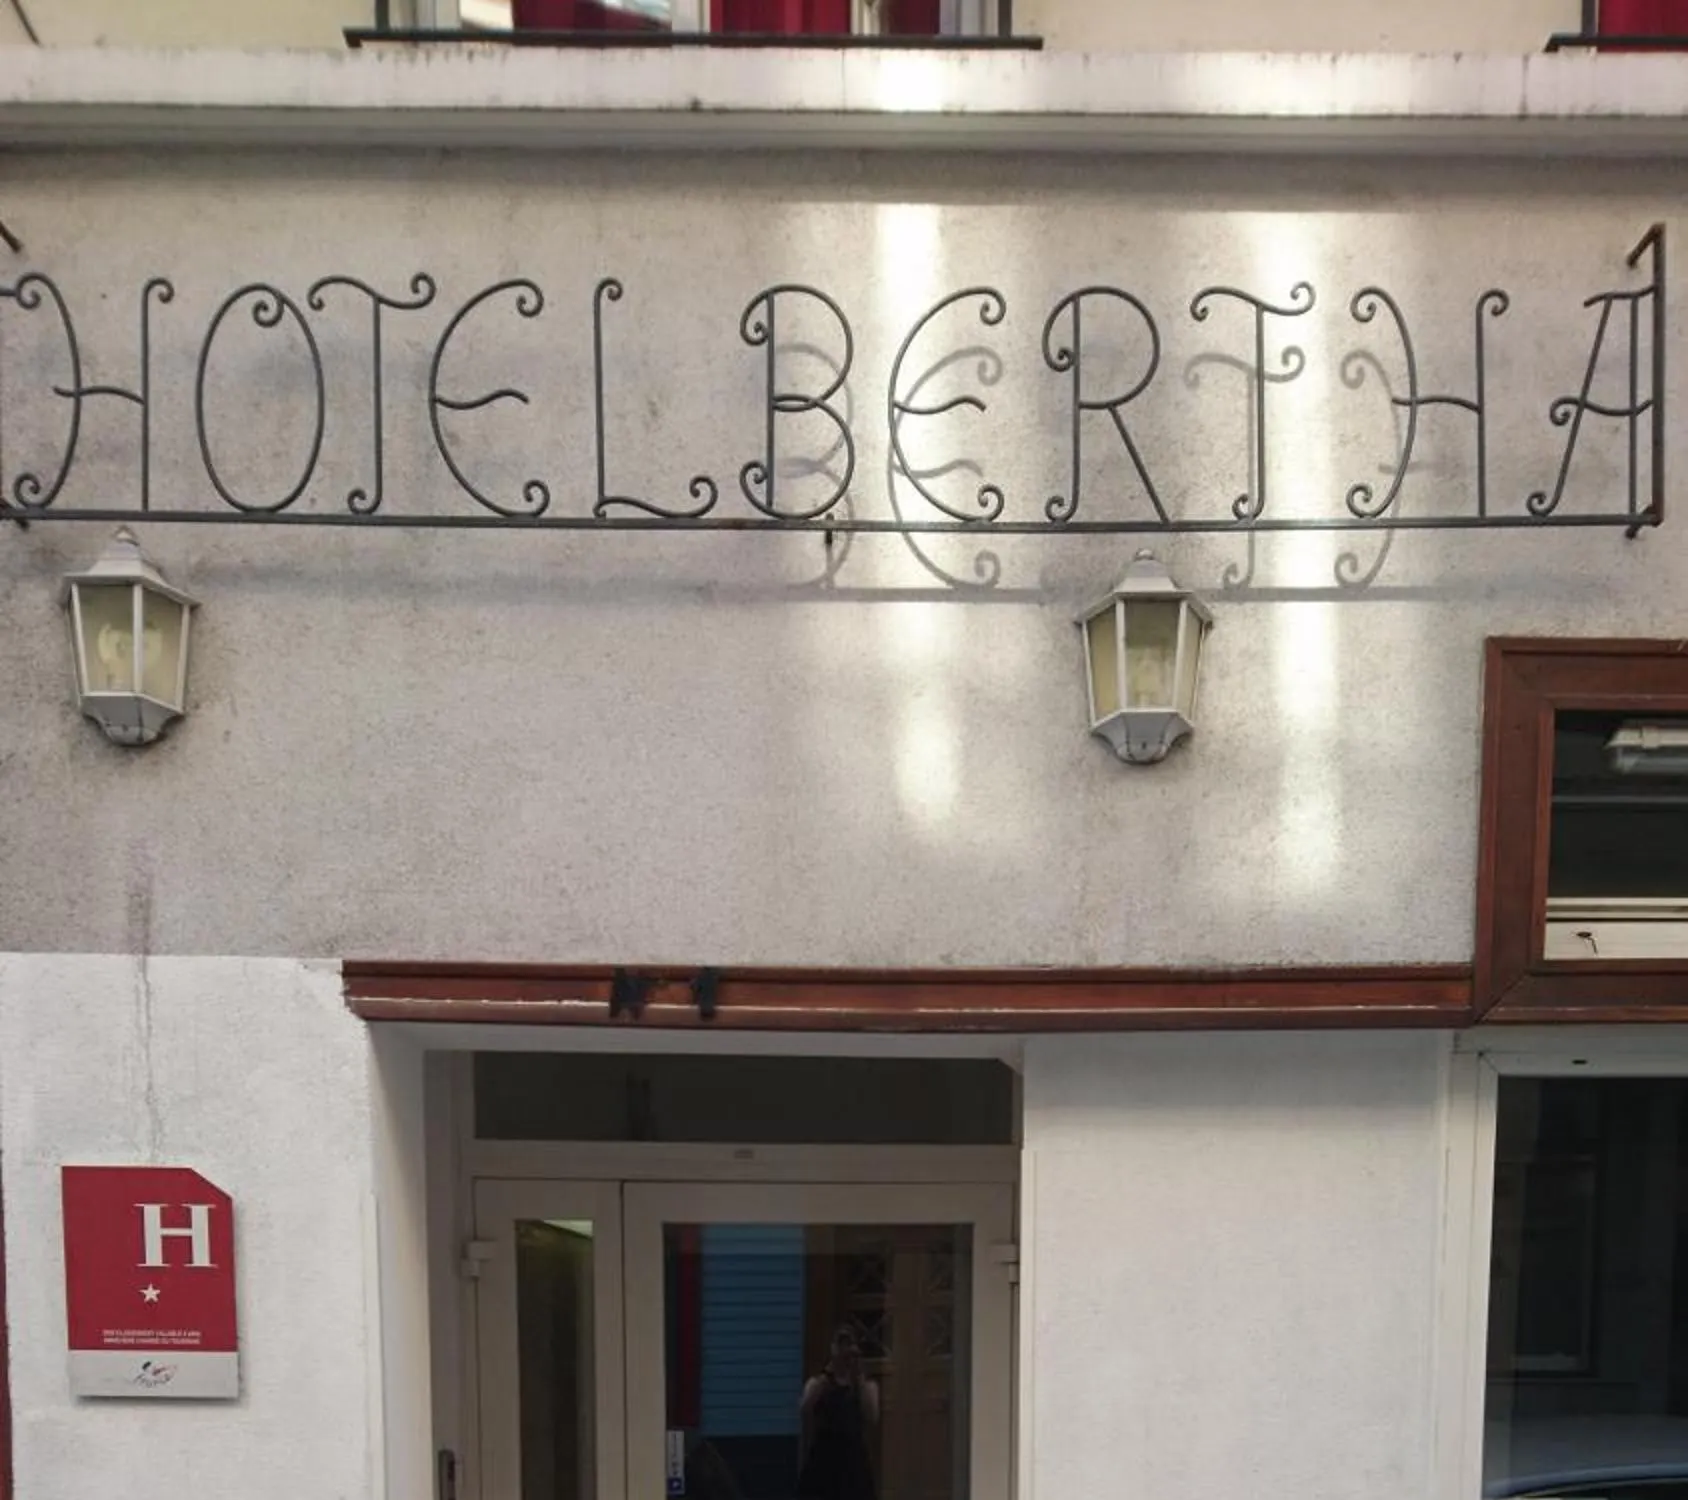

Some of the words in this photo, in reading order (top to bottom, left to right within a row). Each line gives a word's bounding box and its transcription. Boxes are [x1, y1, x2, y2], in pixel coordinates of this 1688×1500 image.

[13, 272, 718, 519] HOTEL
[740, 282, 1655, 523] BERTHA
[135, 1203, 217, 1267] H
